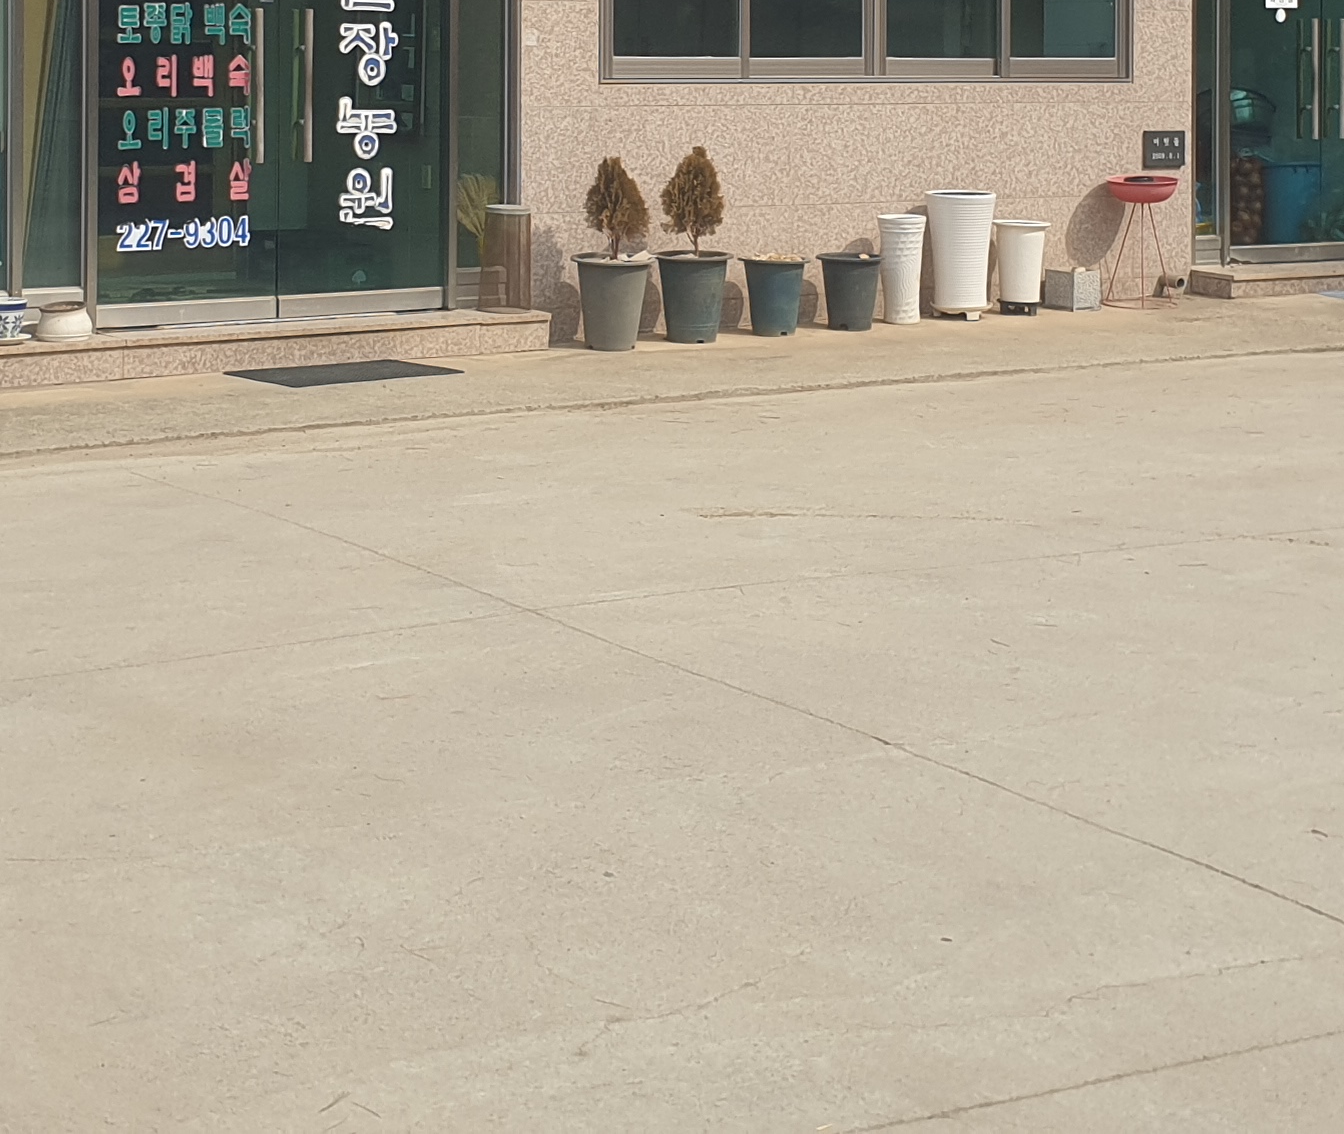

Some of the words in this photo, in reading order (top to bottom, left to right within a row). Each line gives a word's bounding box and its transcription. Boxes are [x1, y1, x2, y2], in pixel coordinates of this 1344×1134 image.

[117, 2, 193, 45] 토종닭
[203, 2, 252, 45] 백숙
[117, 158, 252, 204] 삼겹살
[116, 214, 251, 252] 227-9304
